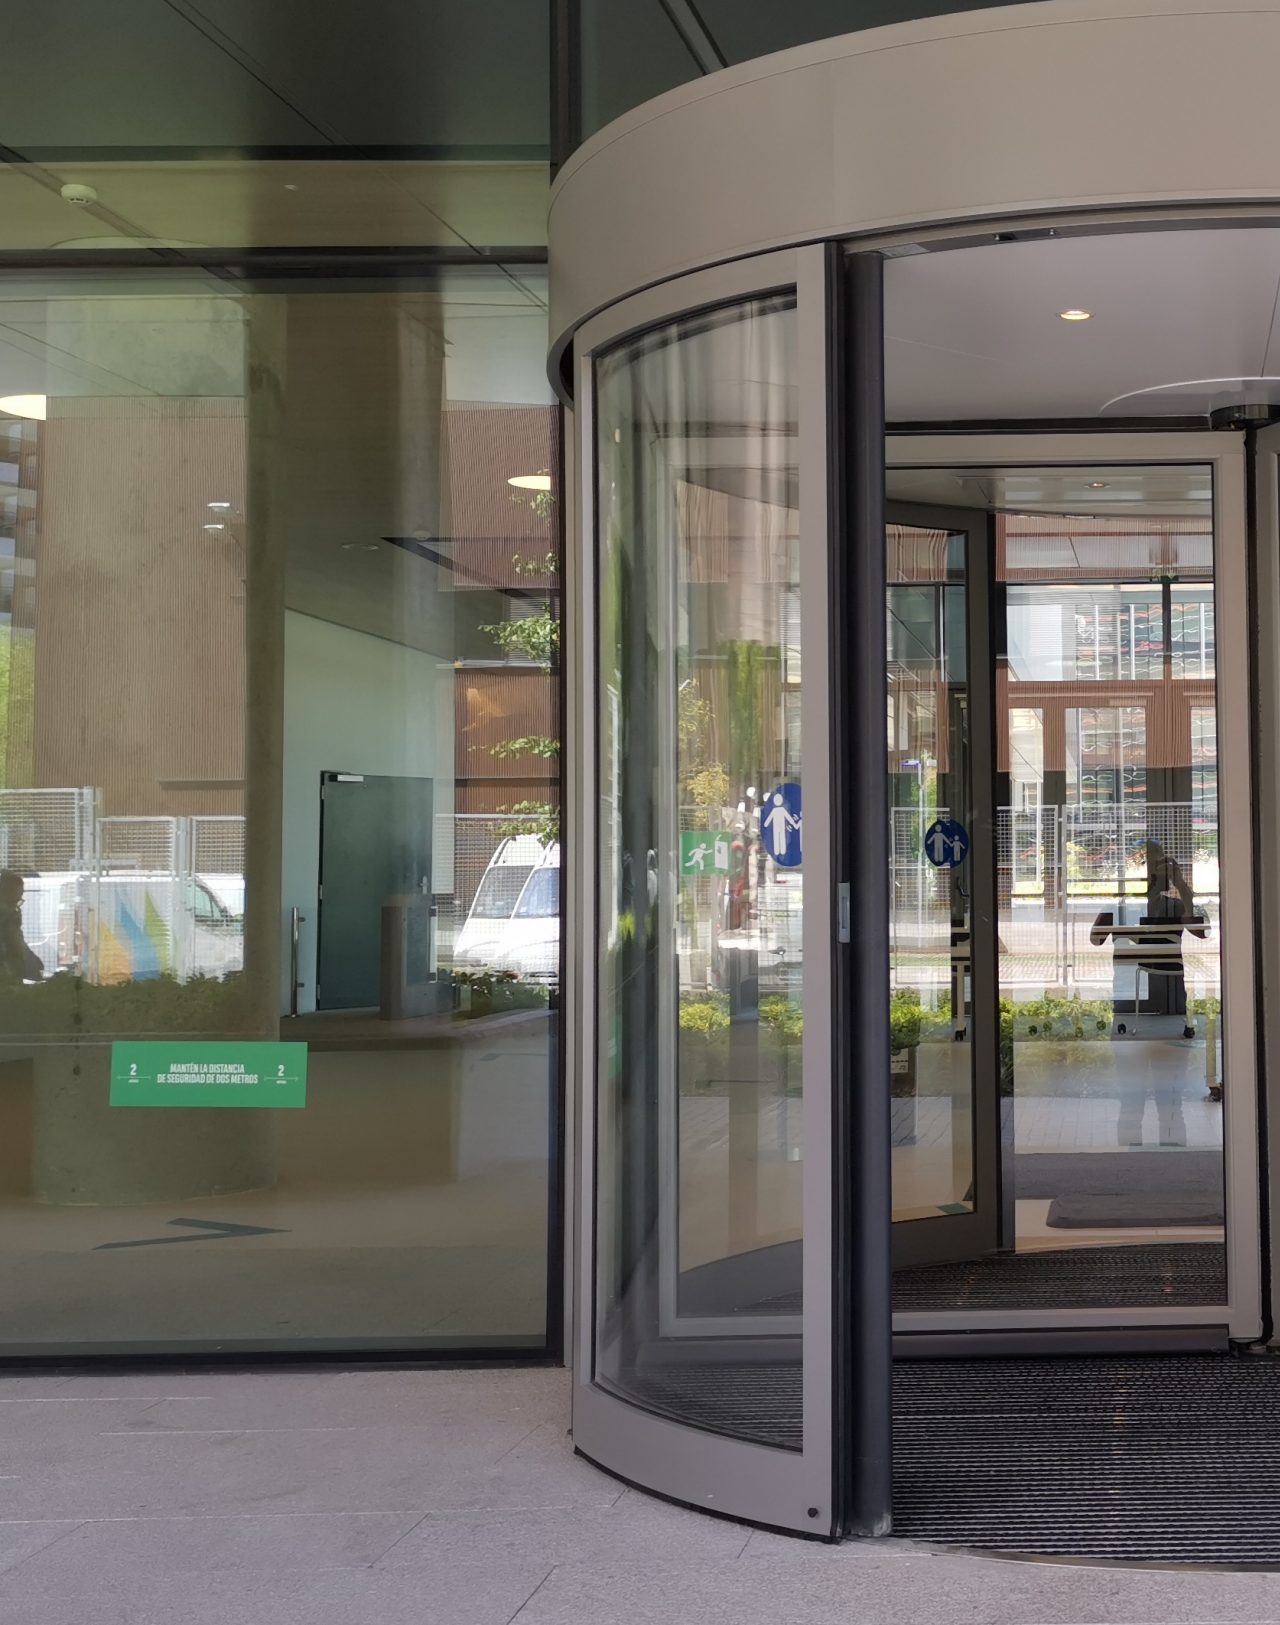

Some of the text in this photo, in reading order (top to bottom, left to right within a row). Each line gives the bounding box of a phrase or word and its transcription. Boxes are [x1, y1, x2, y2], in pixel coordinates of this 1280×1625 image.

[130, 1063, 137, 1075] 2
[170, 1061, 245, 1073] MANTÉN LA DISTANCIA
[277, 1064, 285, 1077] 2
[157, 1073, 258, 1084] DE SEGURIDAD DE DOS METROS
